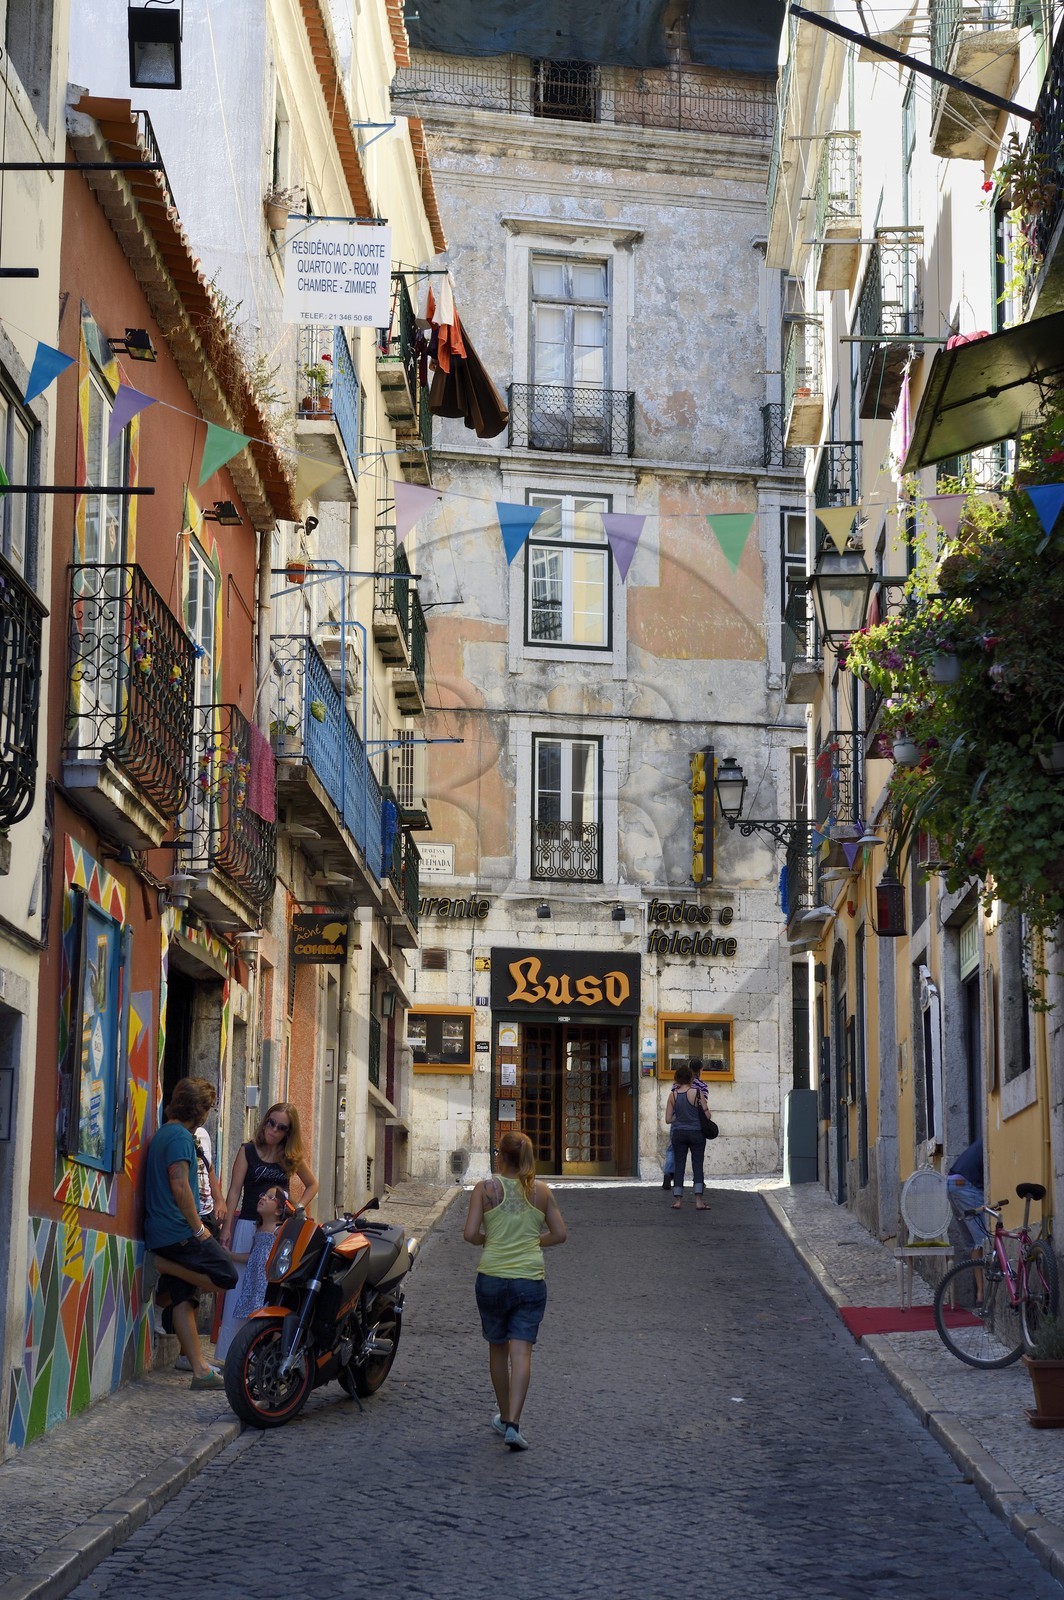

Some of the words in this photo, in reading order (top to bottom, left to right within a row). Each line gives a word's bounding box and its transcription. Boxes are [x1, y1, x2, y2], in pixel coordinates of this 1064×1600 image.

[292, 240, 341, 255] RESIDÊNCIA
[343, 244, 355, 256] DO
[357, 244, 385, 258] NORTE
[298, 260, 331, 274] QUARTO
[333, 261, 347, 275] WC
[353, 262, 379, 276] ROOM
[298, 278, 337, 292] CHAMBRE
[344, 280, 376, 294] ZIMMER
[648, 898, 713, 925] fados
[719, 906, 734, 926] e
[294, 944, 344, 954] COHIBA
[647, 929, 738, 957] folclore
[506, 956, 631, 1007] Luso
[478, 997, 486, 1006] 10
